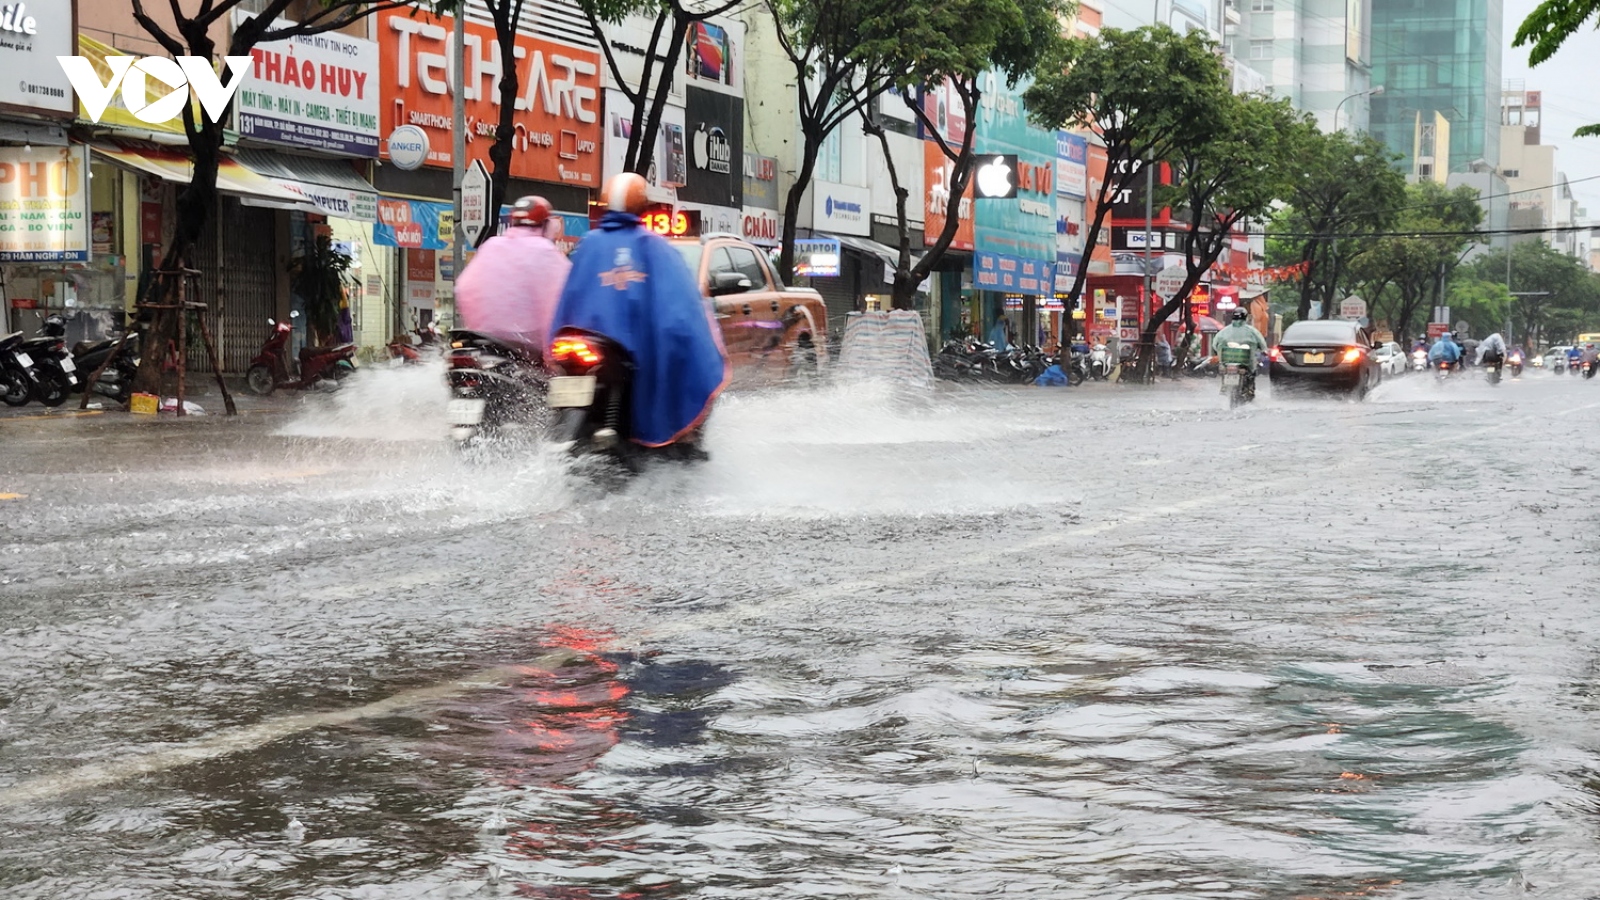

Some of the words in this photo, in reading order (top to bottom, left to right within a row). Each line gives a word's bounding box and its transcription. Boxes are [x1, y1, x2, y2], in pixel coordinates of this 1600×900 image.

[314, 36, 329, 50] MTV
[330, 40, 342, 52] TIN
[342, 44, 358, 58] HỌC
[251, 44, 316, 90] THẢO
[320, 63, 367, 100] HUY
[242, 88, 256, 108] MÁY
[258, 89, 273, 111] TÍNH
[278, 95, 292, 114] MÁY
[293, 99, 301, 116] IN
[305, 102, 331, 121] CAMERA
[335, 105, 351, 124] THIẾT
[360, 112, 377, 132] MẠNG
[410, 110, 453, 130] SMARTPHONE
[240, 115, 254, 134] 131
[391, 142, 422, 151] ANKER
[577, 139, 595, 153] LAPTOP
[709, 135, 731, 161] iHub
[743, 212, 776, 239] CHÂU
[35, 252, 58, 260] NGHI
[800, 243, 837, 252] LAPTOP
